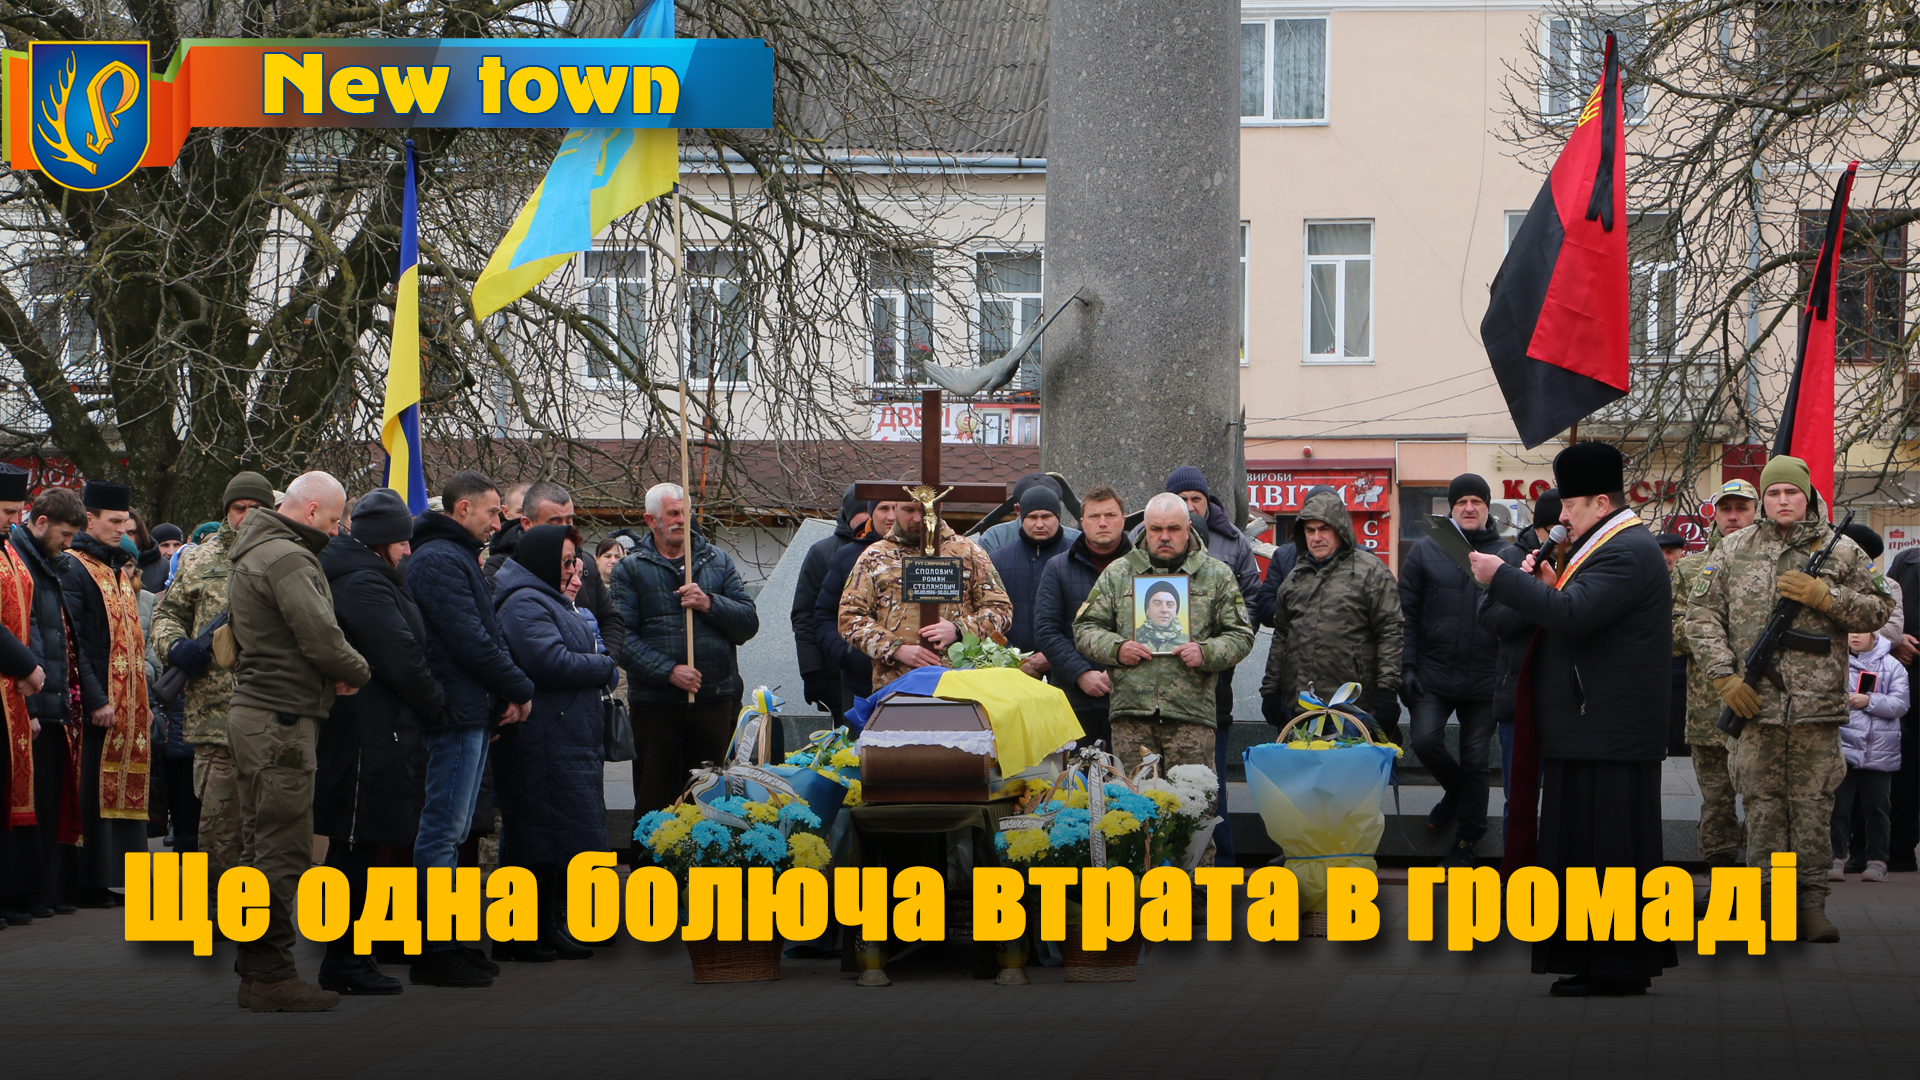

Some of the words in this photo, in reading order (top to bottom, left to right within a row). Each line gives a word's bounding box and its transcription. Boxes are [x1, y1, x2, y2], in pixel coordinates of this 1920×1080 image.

[877, 406, 951, 432] ДВЕІ
[1247, 472, 1292, 482] ВИРОБИ
[1502, 479, 1677, 503] КОСИ
